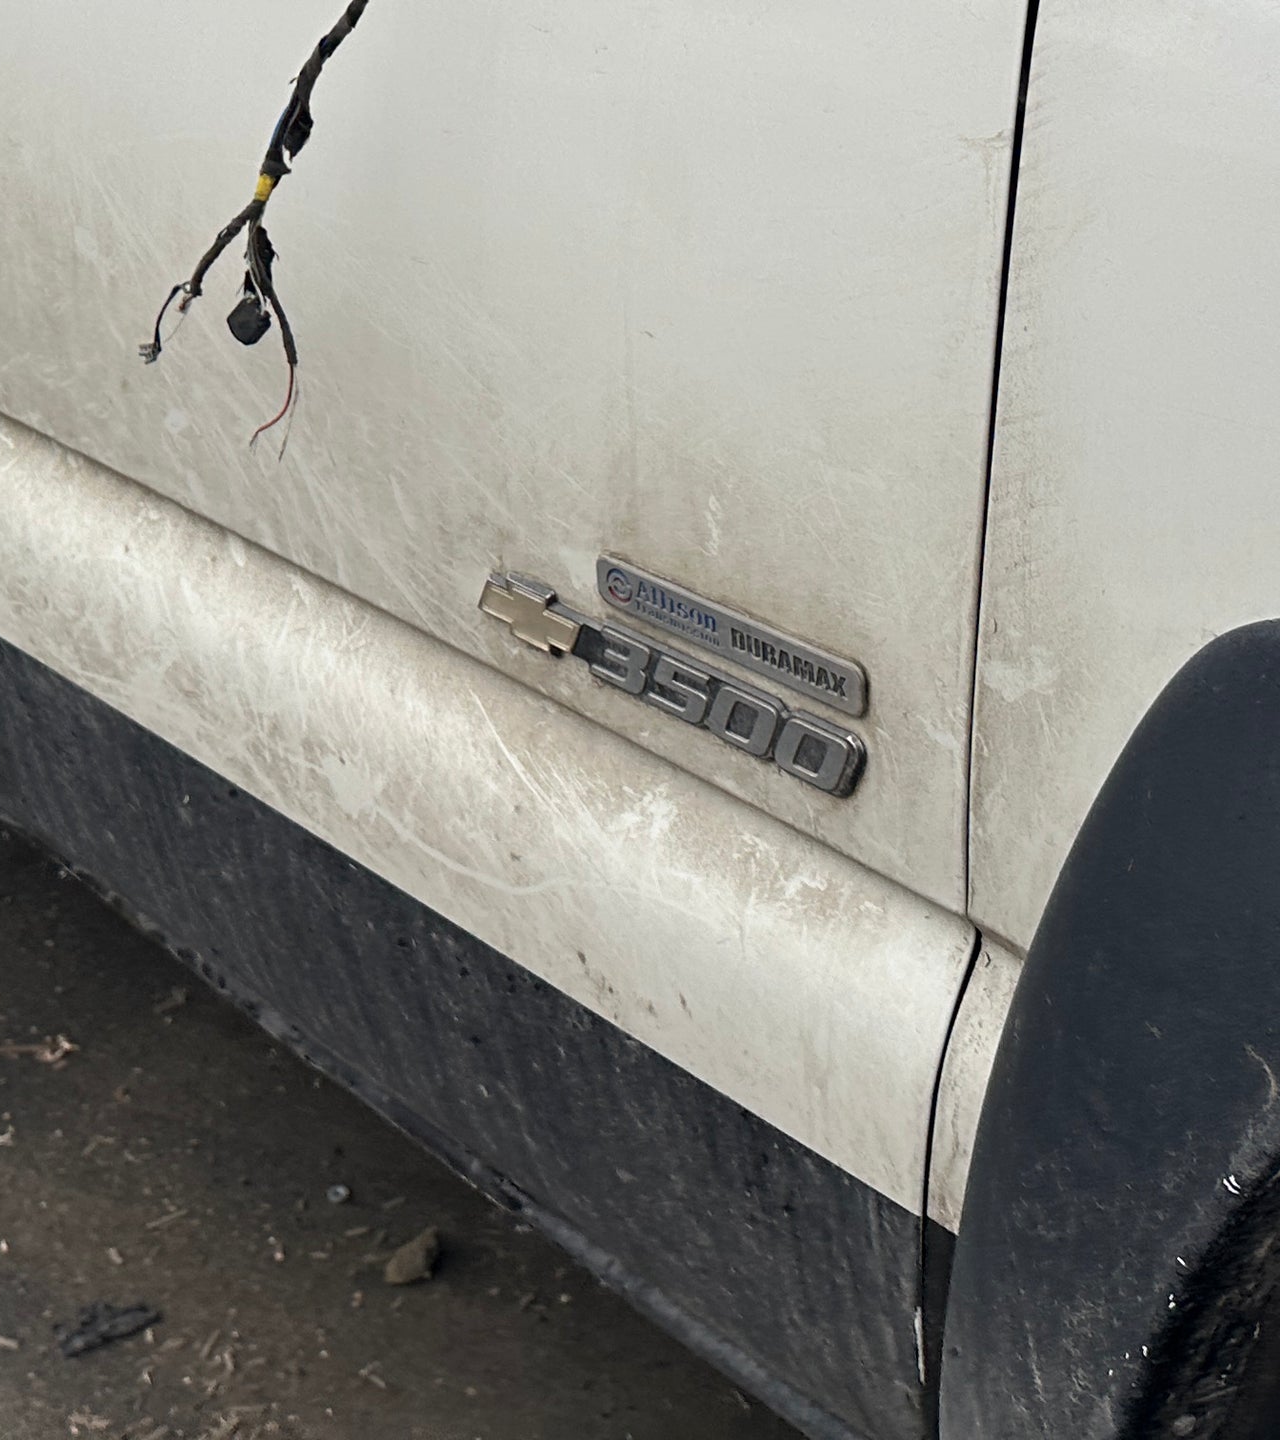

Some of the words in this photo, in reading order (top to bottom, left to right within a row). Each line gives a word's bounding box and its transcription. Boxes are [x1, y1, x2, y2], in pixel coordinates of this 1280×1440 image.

[636, 580, 717, 633] Allison
[729, 626, 848, 699] DURAMAX
[588, 623, 865, 797] 3500
